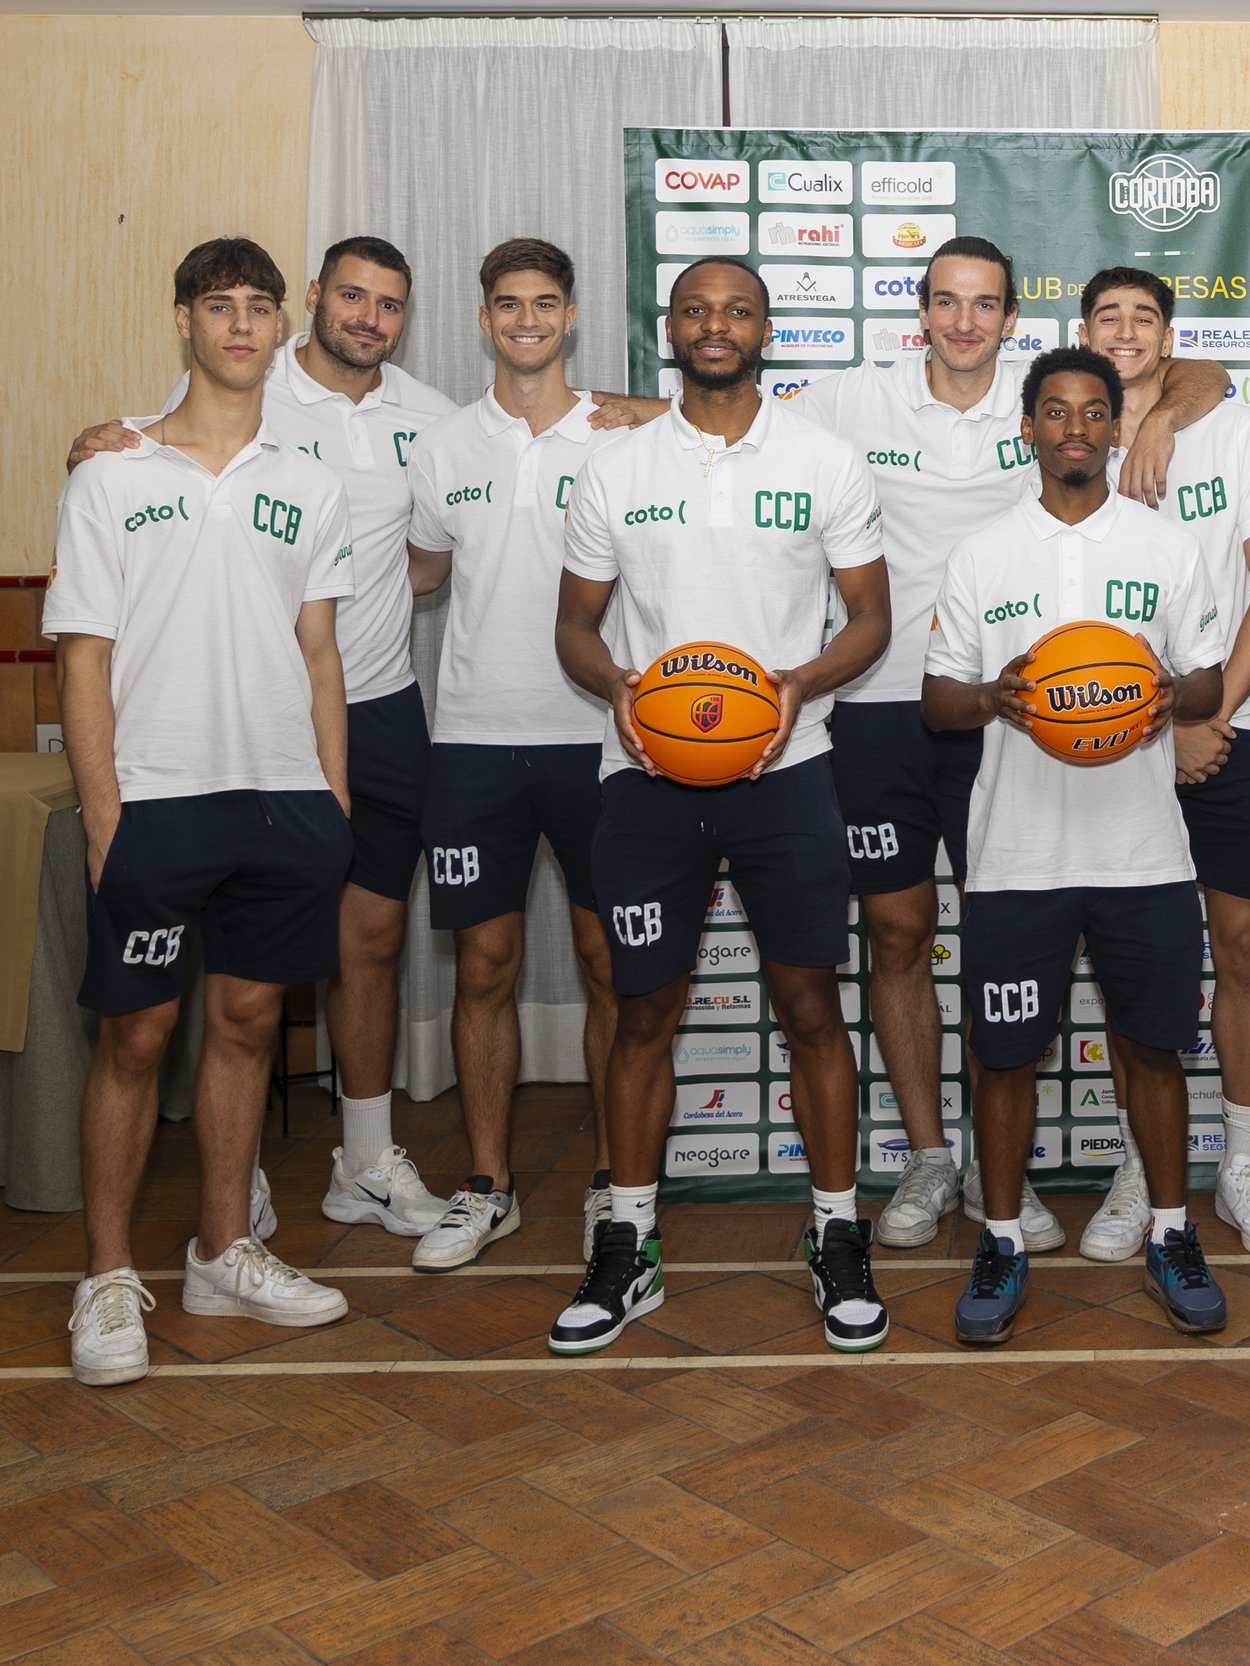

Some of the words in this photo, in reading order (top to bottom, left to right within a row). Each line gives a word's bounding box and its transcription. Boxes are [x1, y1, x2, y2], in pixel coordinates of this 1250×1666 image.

[665, 171, 741, 191] COVAP
[788, 173, 843, 192] Cualix
[871, 177, 933, 193] efficold
[680, 225, 741, 237] aquasimply
[798, 225, 840, 242] rahi
[771, 329, 845, 343] PINVECO
[1202, 330, 1250, 340] REALE
[755, 490, 812, 534] CCB
[1177, 475, 1228, 522] CCB
[253, 492, 303, 546] CCB
[1105, 579, 1160, 624] CCB
[660, 653, 758, 687] Wilson
[1045, 681, 1143, 713] Wilson
[847, 822, 900, 861] CCB
[433, 846, 480, 887] CCB
[612, 902, 663, 947] CCB
[122, 925, 185, 968] CCB
[983, 979, 1040, 1023] CCB
[690, 1044, 752, 1056] aquasimply
[684, 1111, 715, 1120] Cordobesa
[715, 1110, 725, 1118] del
